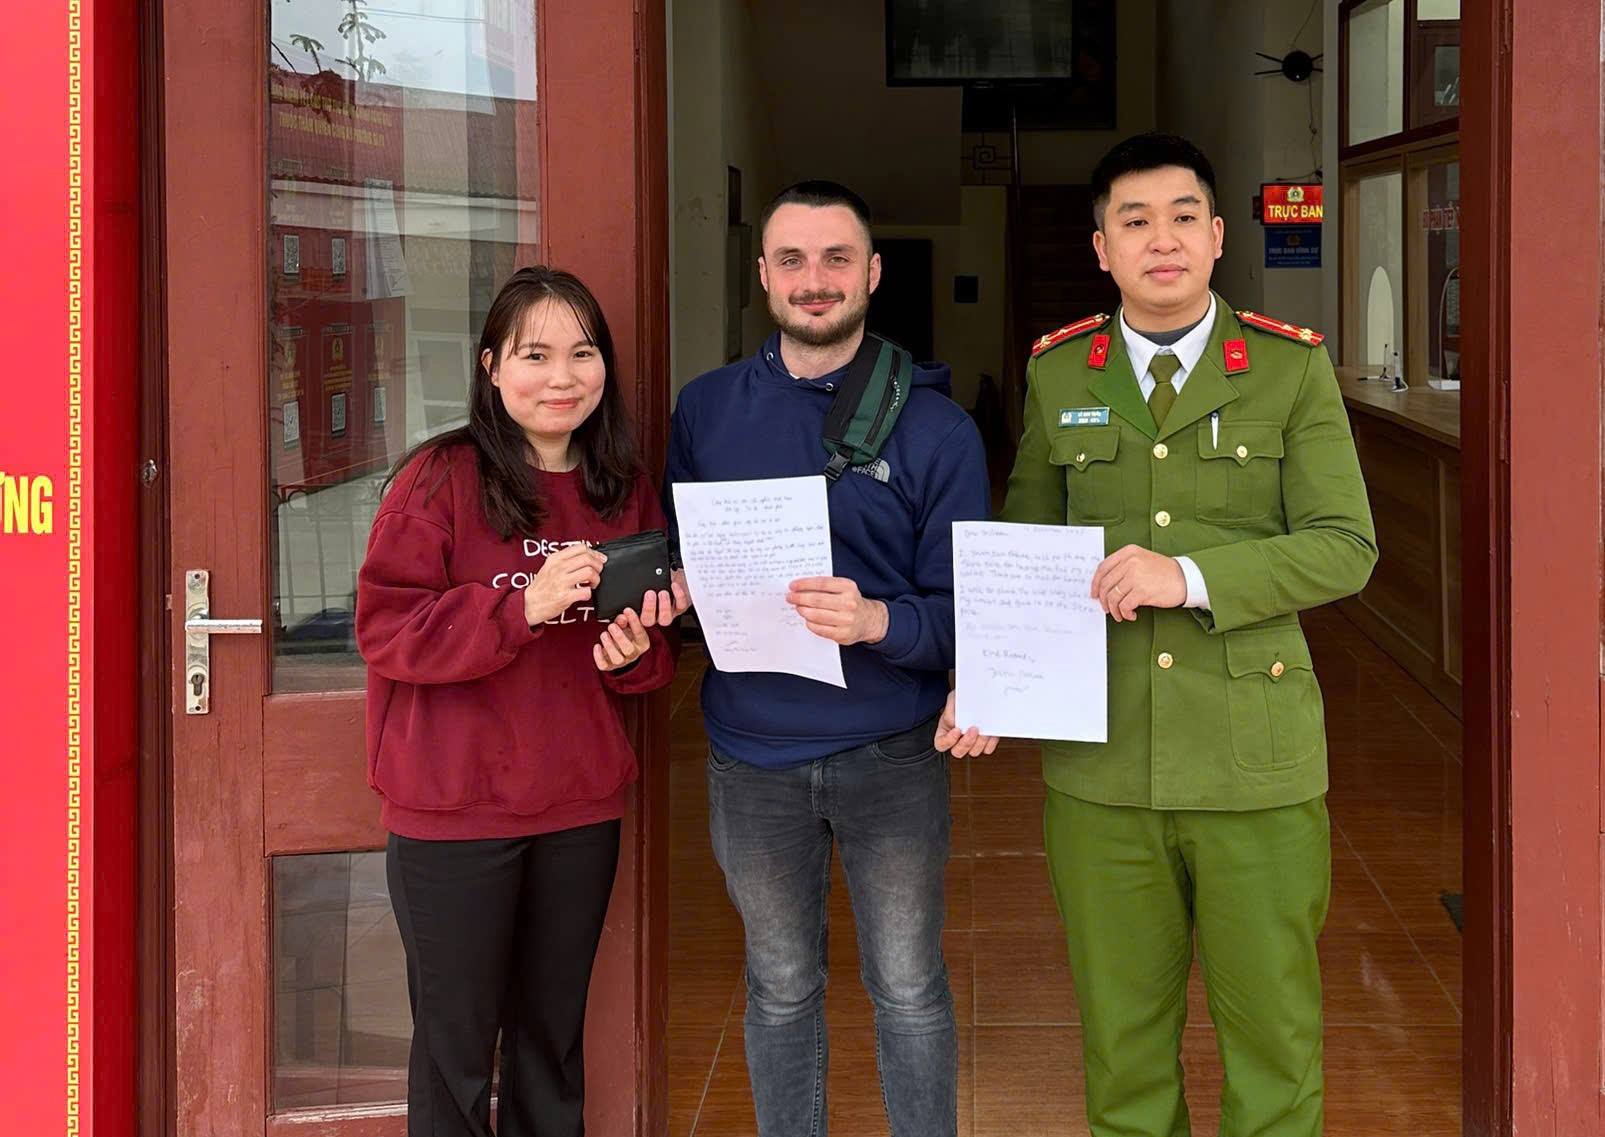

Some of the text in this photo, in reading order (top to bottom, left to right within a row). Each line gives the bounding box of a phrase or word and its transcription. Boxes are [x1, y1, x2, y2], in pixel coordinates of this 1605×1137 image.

[1268, 205, 1323, 220] TRỰC BAN
[0, 472, 53, 535] NG
